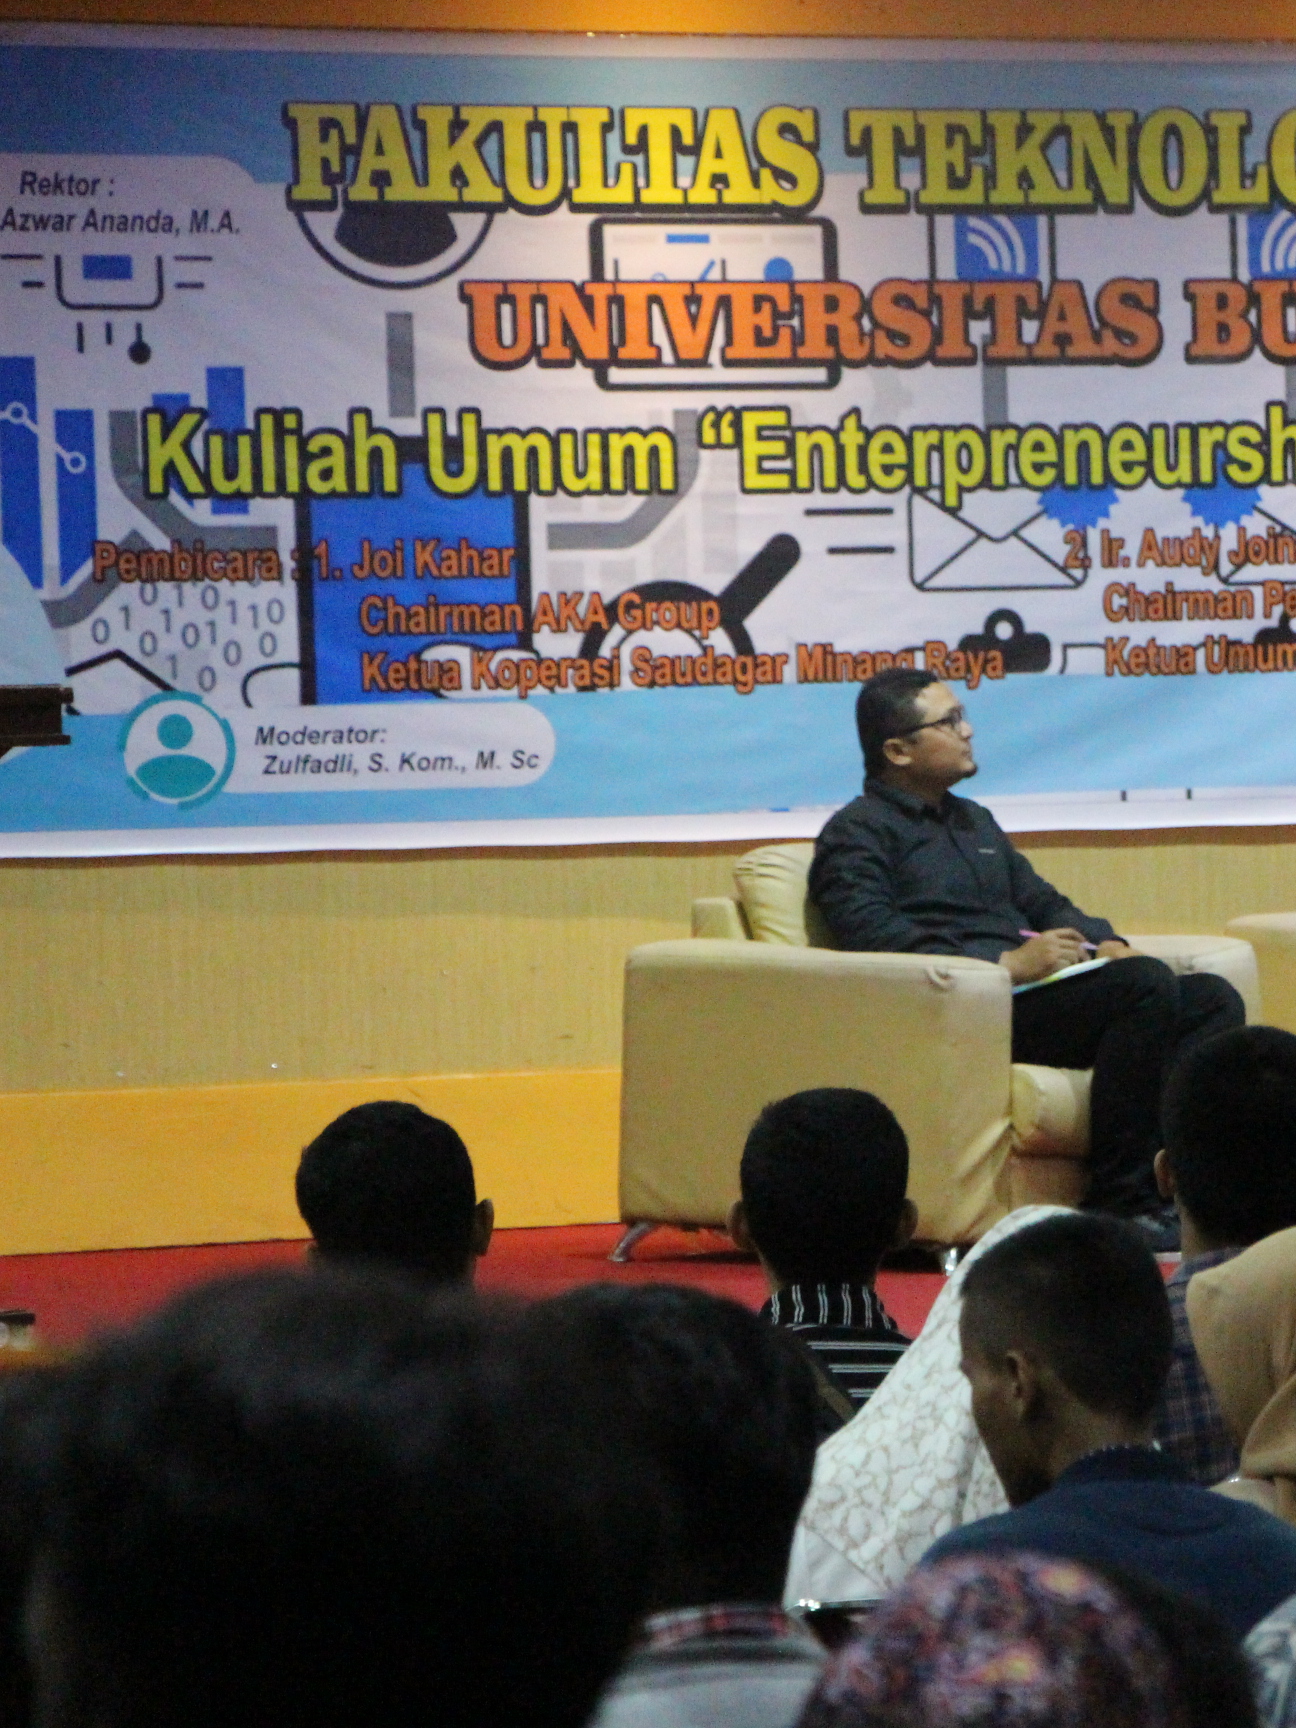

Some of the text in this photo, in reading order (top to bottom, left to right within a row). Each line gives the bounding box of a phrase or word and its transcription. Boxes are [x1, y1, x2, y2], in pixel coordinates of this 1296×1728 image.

[286, 103, 822, 214] FAKULTAS
[0, 207, 240, 236] Azwar Ananda, M.A.
[459, 278, 1162, 368] UNIVERSITAS
[143, 407, 400, 498] Kuliah
[422, 407, 678, 496] Umum
[314, 545, 342, 580] 1.
[352, 539, 406, 579] Joi
[414, 537, 515, 579] Kahar
[1063, 530, 1091, 569] 2.
[1101, 528, 1130, 568] Ir.
[1137, 527, 1221, 576] Audy
[360, 590, 721, 637] Chairman AKA Group
[1103, 582, 1254, 622] Chairman
[360, 651, 461, 692] Ketua
[470, 649, 620, 698] Koperasi
[630, 645, 788, 694] Saudagar
[924, 639, 1006, 689] Raya
[1104, 636, 1196, 676] Ketua
[254, 725, 388, 746] Moderator:
[262, 753, 359, 777] Zulfadli,
[368, 752, 389, 773] S.
[475, 750, 501, 770] M.
[510, 749, 540, 769] Sc
